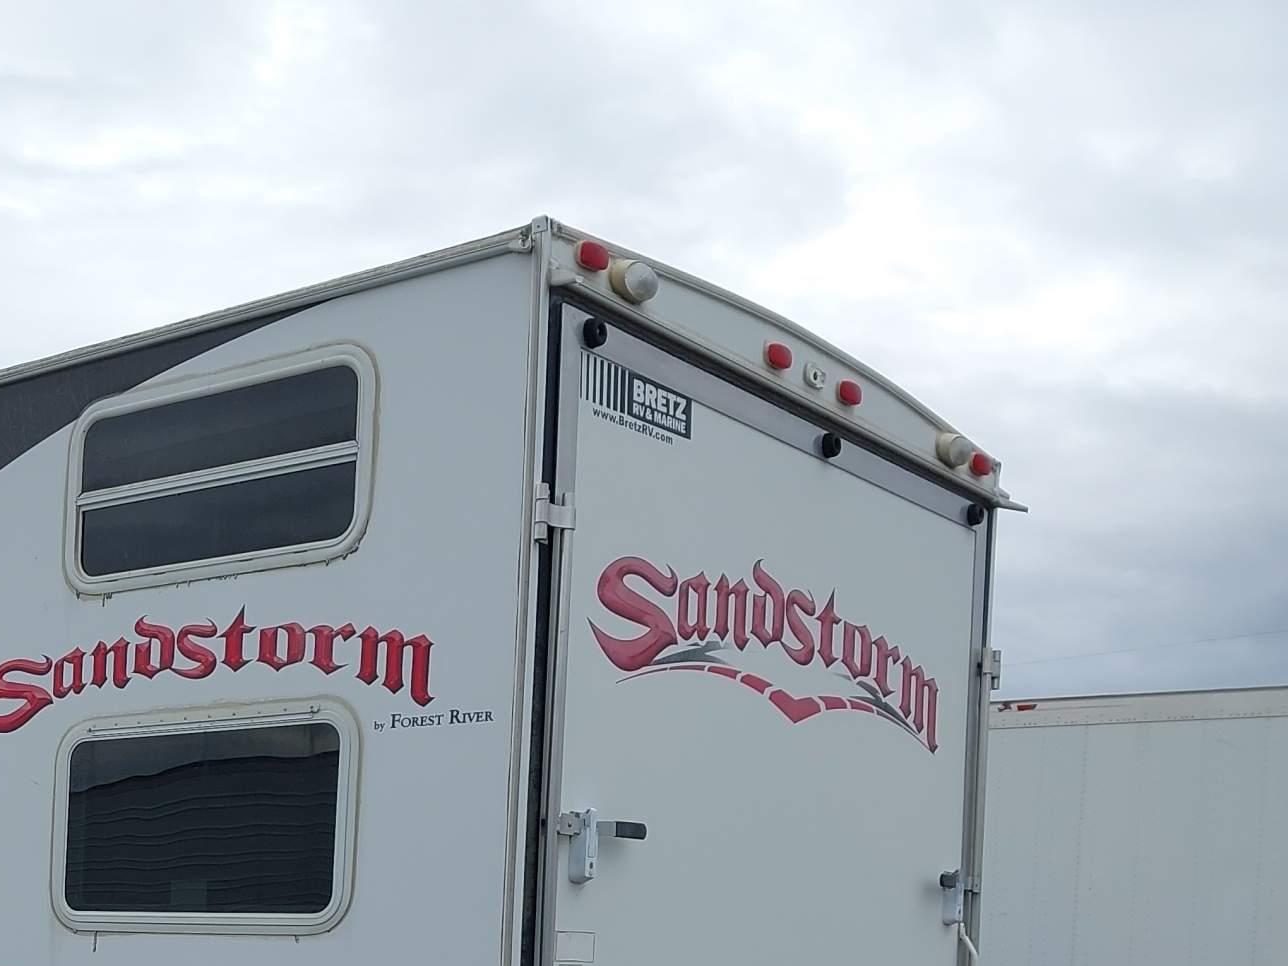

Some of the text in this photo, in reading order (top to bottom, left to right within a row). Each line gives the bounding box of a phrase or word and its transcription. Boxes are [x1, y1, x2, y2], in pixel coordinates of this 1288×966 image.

[632, 402, 687, 434] RV & MARINE
[633, 378, 687, 421] BRETZ
[592, 407, 673, 446] www.BretzRV.com
[587, 556, 939, 754] Sandstorm
[373, 709, 494, 732] by FOREST RIVER
